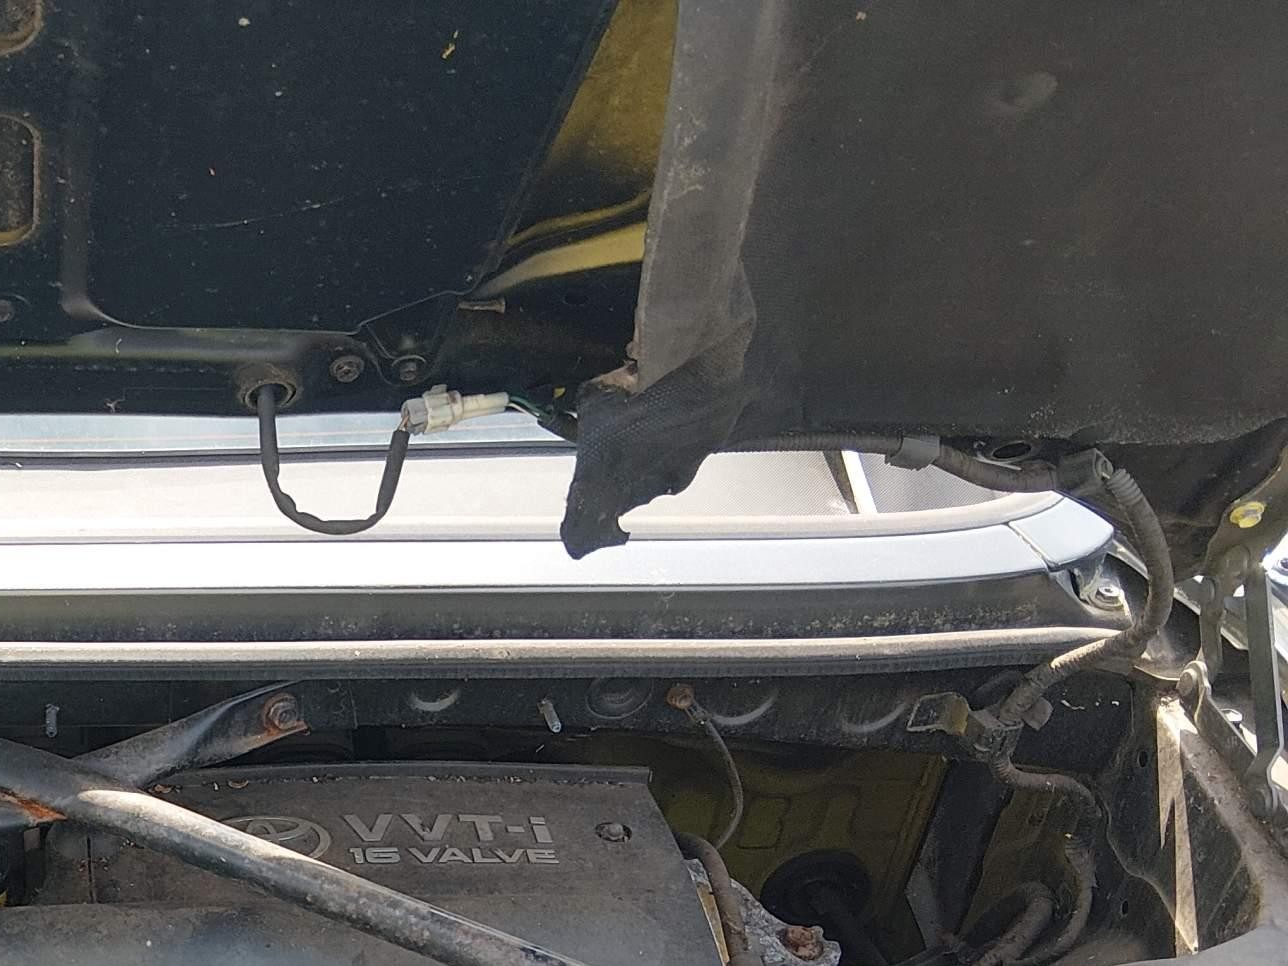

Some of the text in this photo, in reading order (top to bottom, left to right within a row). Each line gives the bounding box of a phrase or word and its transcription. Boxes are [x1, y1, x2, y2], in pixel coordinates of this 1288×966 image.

[343, 813, 554, 844] VVT-i
[348, 846, 560, 865] 16 VALVE
